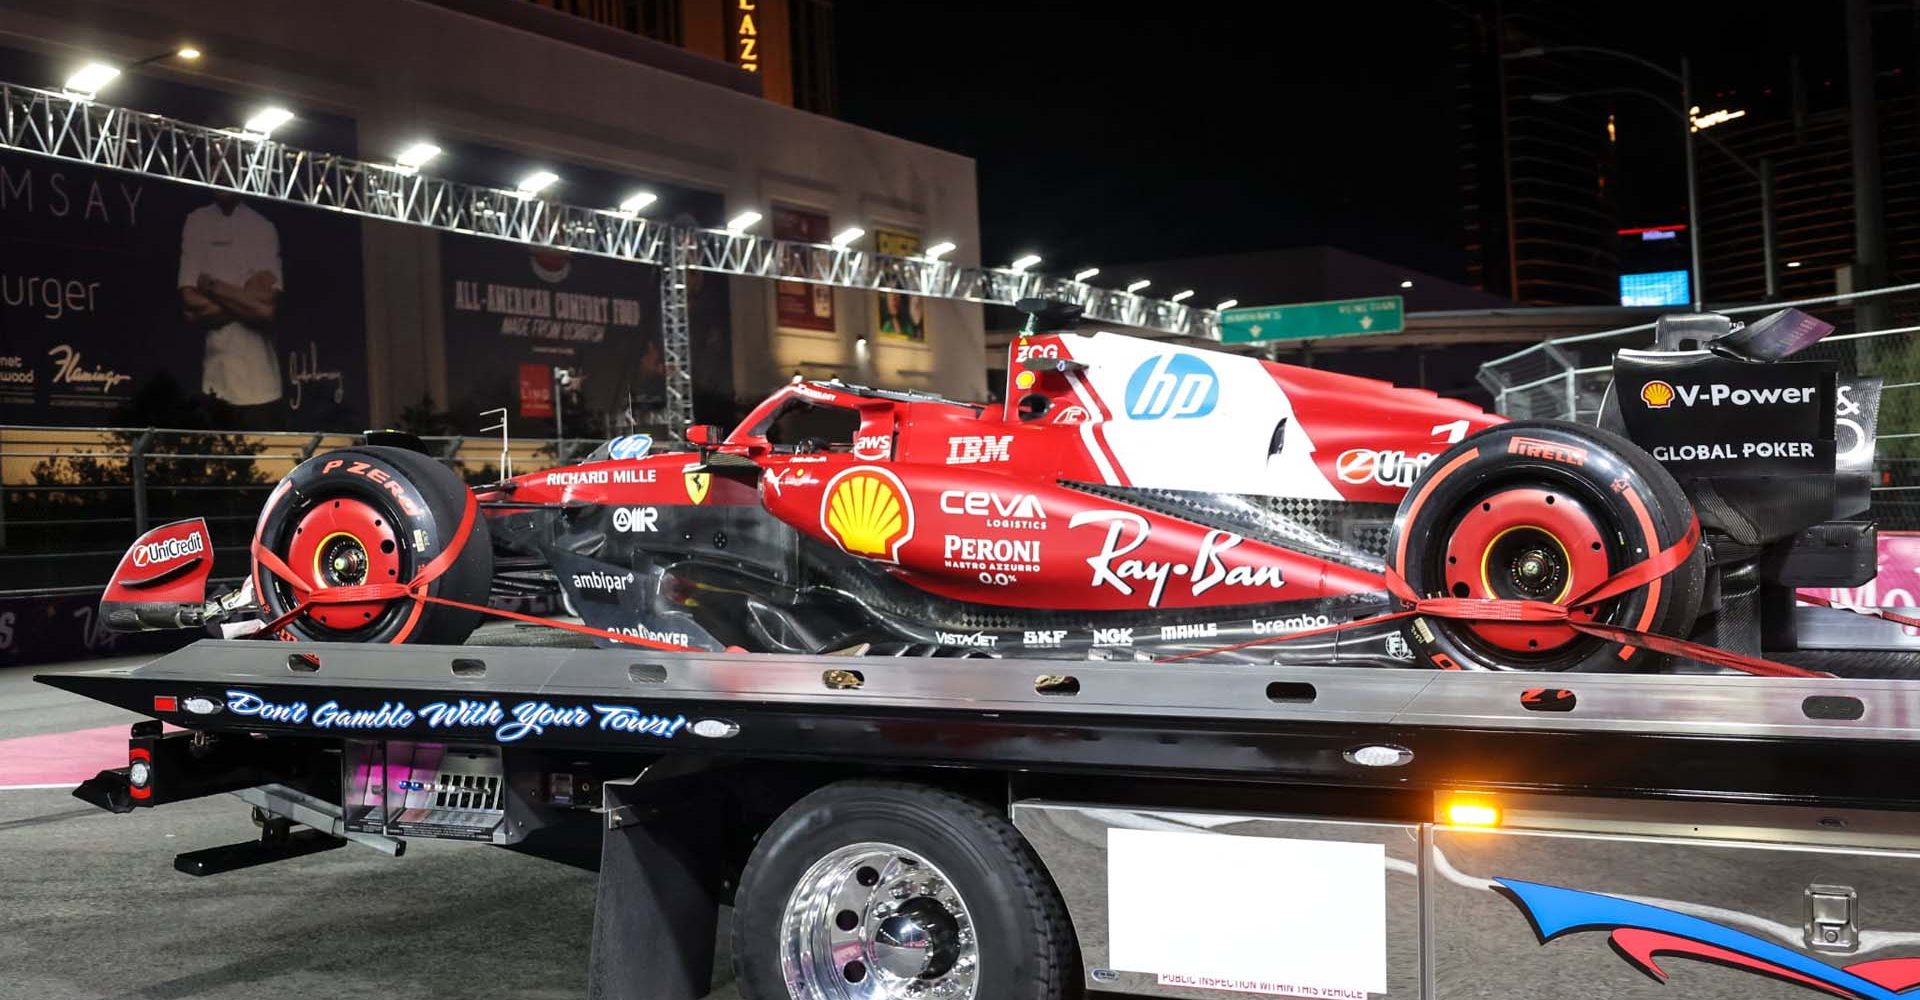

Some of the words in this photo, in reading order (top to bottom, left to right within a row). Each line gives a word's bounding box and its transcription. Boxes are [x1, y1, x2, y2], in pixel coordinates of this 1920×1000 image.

[1, 274, 101, 319] urger
[455, 280, 551, 317] ALL-AMERICAN
[48, 344, 132, 393] Flamingo
[1130, 353, 1216, 420] hp
[1676, 384, 1816, 407] V-Power
[857, 435, 891, 451] aws
[946, 435, 1015, 465] IBM
[1507, 436, 1588, 467] PIRELLI
[1653, 443, 1738, 461] GLOBAL
[1742, 441, 1815, 458] POKER
[346, 460, 425, 518] ZERO
[546, 470, 608, 486] RICHARD
[613, 469, 656, 483] MILLE
[986, 519, 1047, 530] LOGISTICS
[149, 532, 203, 562] UniCredit
[944, 534, 1041, 562] PERONI
[989, 563, 1041, 573] AZZURRO
[572, 571, 629, 593] ambipar
[1093, 627, 1134, 644] NGK
[1161, 622, 1218, 640] MAHLE
[1252, 613, 1330, 636] brembo
[1023, 630, 1068, 645] SKF
[226, 690, 307, 722] Don't
[312, 703, 415, 729] Gamble
[419, 700, 503, 729] With
[496, 700, 590, 742] Your
